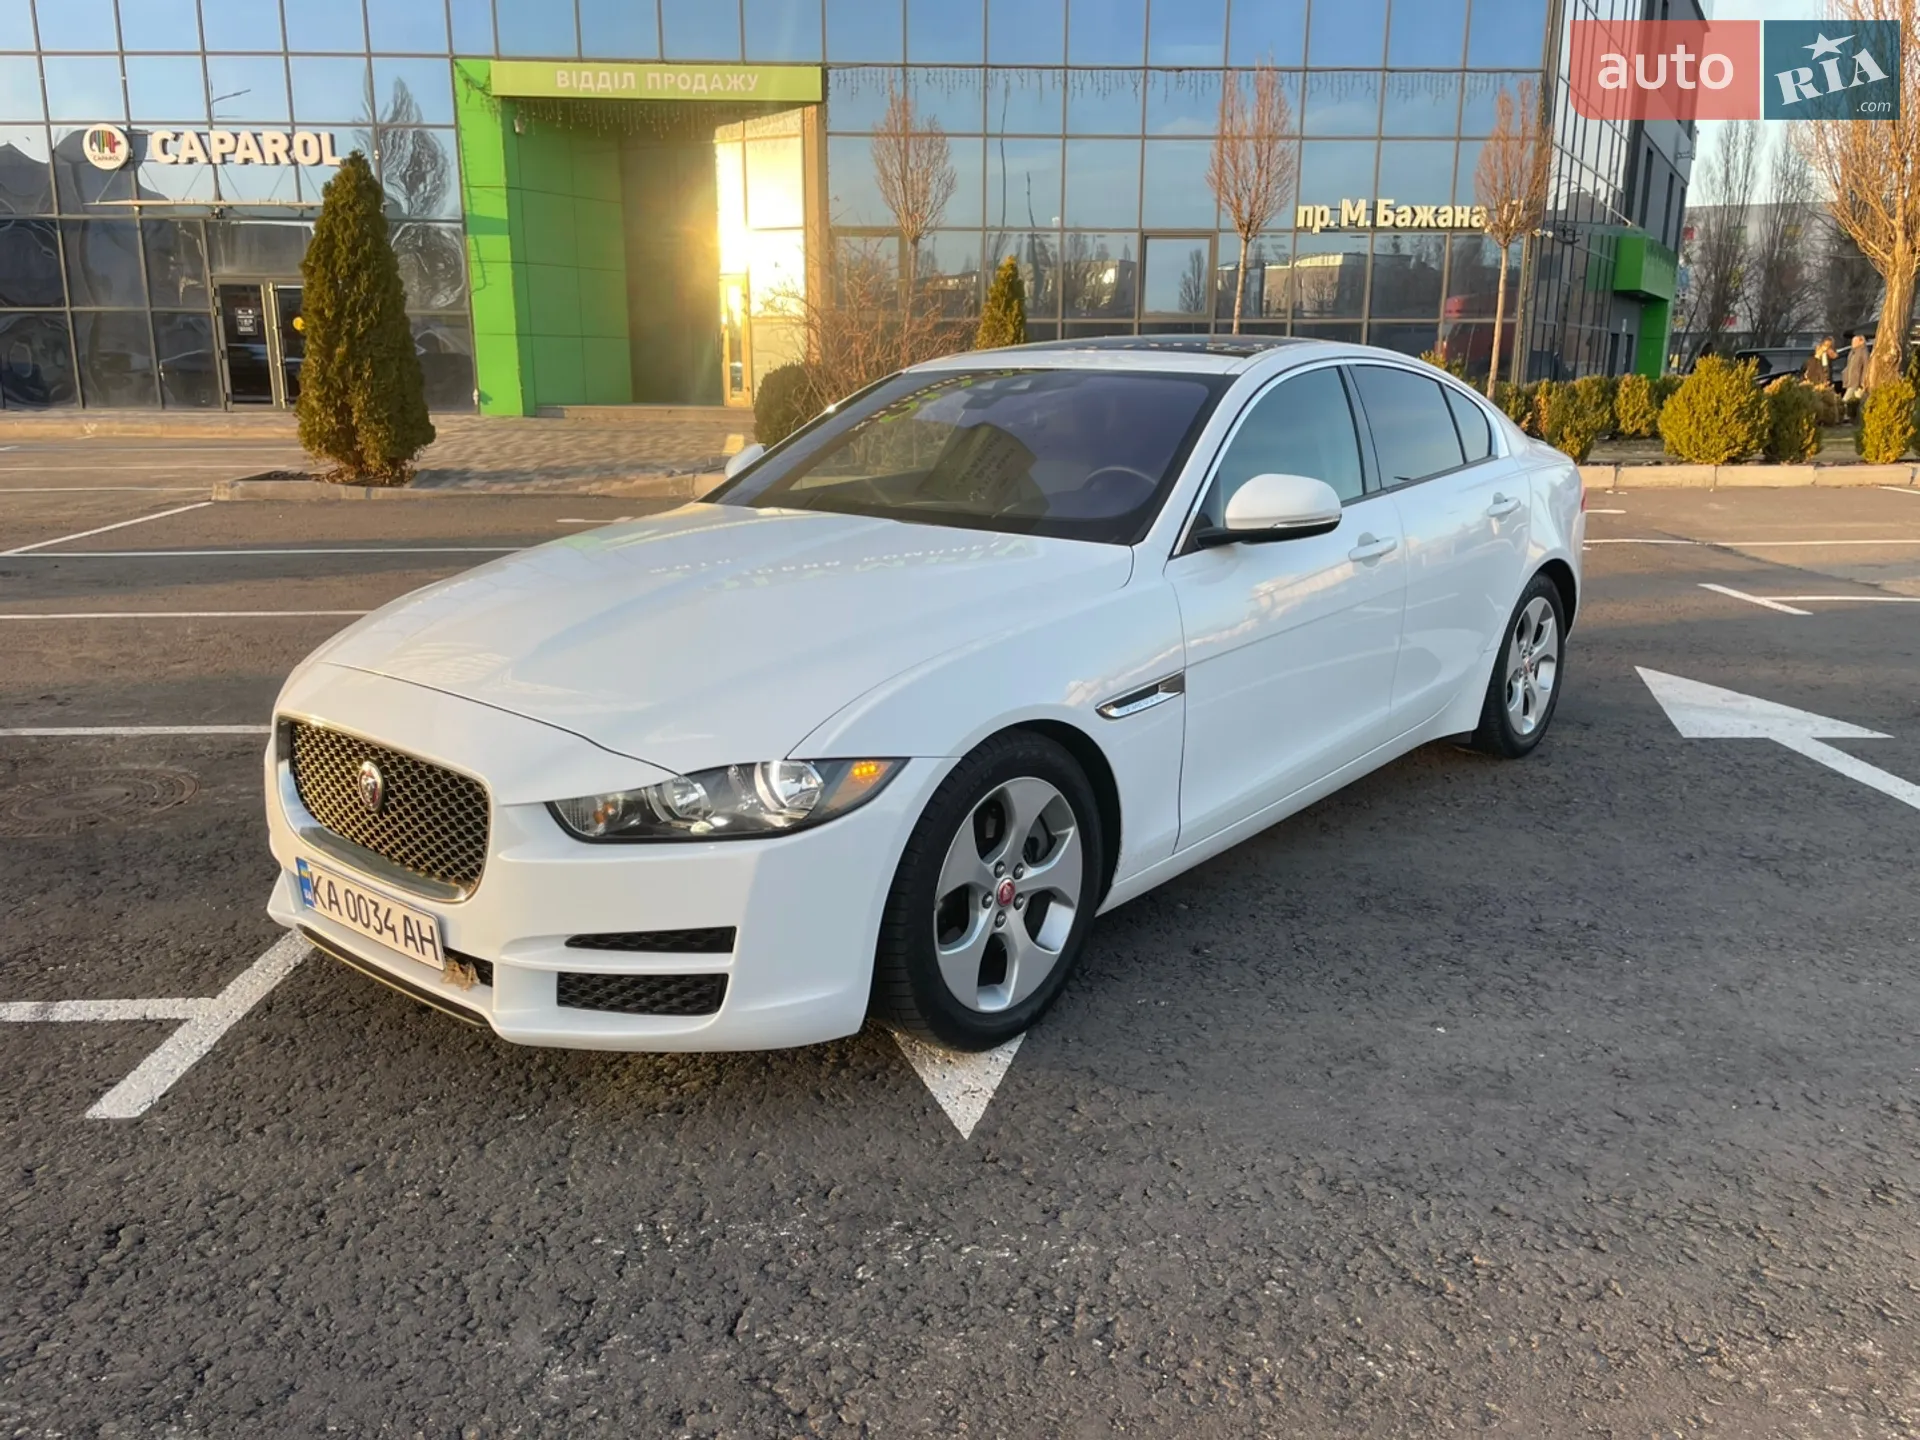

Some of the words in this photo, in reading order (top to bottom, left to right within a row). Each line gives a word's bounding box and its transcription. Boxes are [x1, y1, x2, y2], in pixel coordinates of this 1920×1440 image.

[556, 70, 636, 92] ВІДДІЛ
[646, 72, 759, 94] ПРОДАЖУ
[151, 129, 343, 166] CAPAROL
[311, 871, 343, 917] KA
[344, 888, 399, 944] 0034
[402, 914, 440, 961] AH
